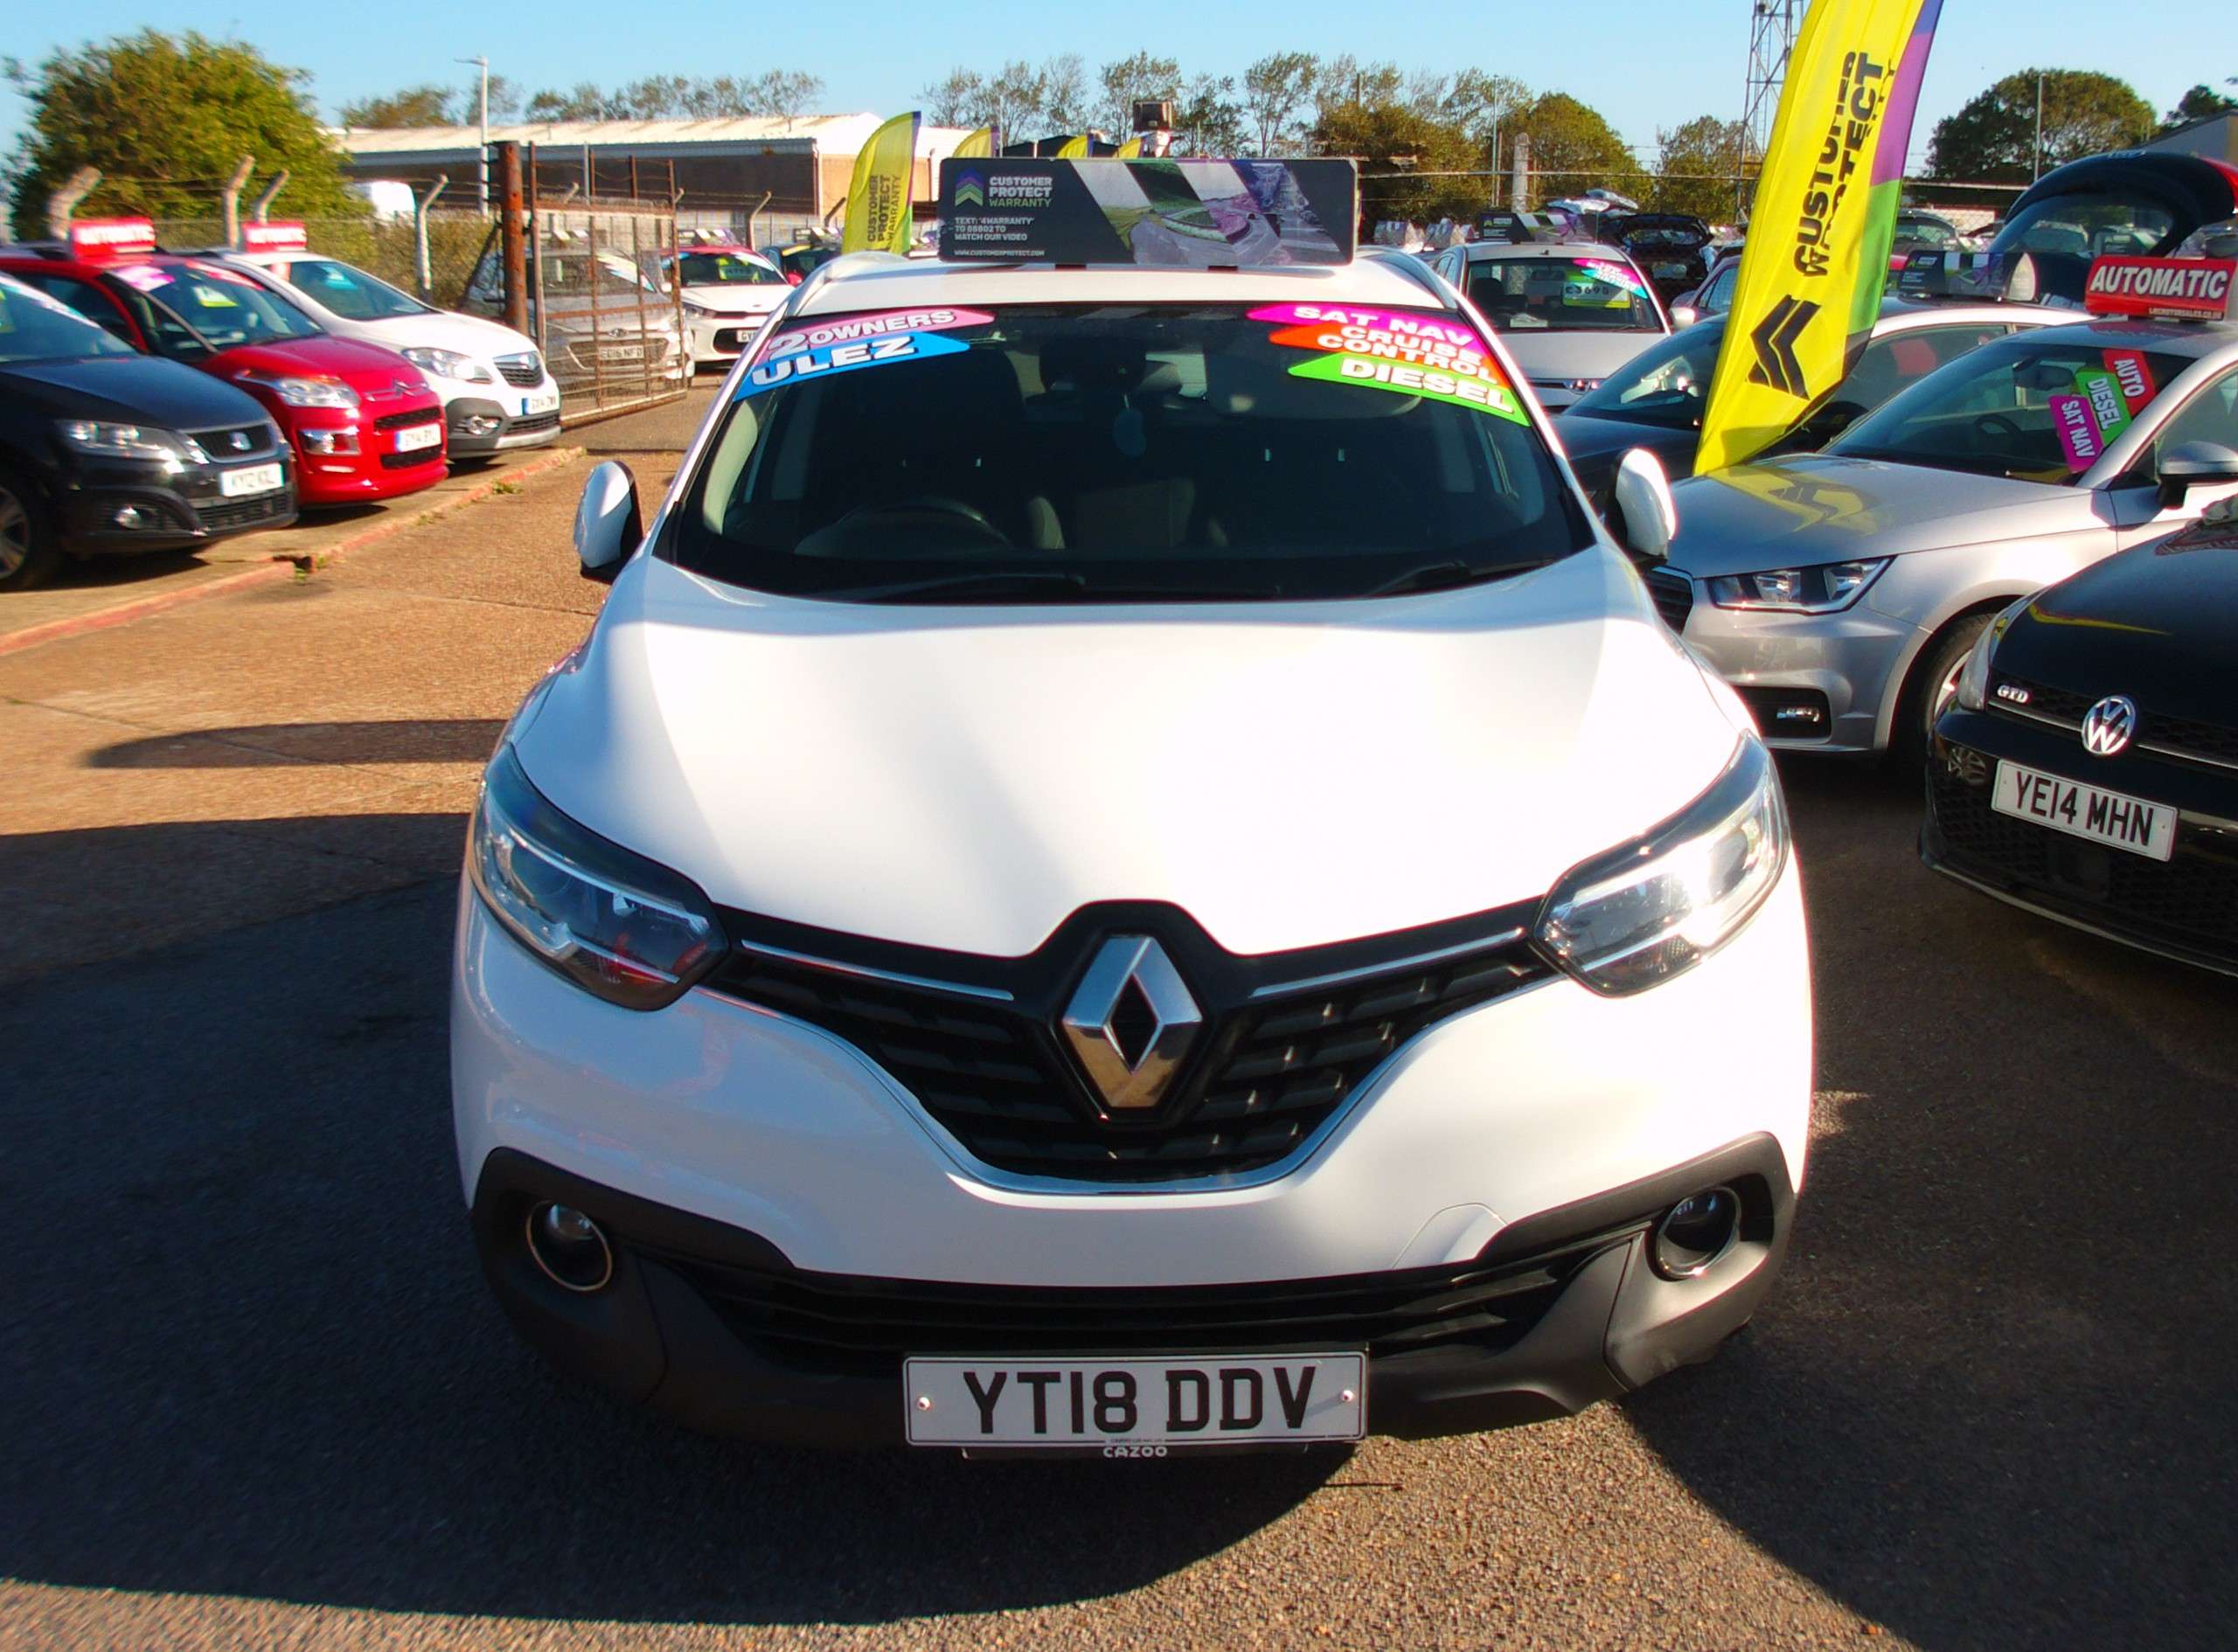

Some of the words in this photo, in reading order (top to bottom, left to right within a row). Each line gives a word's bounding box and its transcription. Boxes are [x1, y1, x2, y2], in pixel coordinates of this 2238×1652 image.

[989, 177, 1053, 186] CUSTOMER
[989, 186, 1053, 198] PROTECT
[867, 176, 879, 242] CUSTOMER
[878, 175, 891, 241] PROTECT
[886, 175, 900, 240] WARRANTY
[989, 198, 1053, 207] WARRANTY
[2089, 265, 2228, 300] AUTOMATIC
[807, 310, 956, 345] OWNERS
[1293, 306, 1379, 327] SAT
[1389, 320, 1475, 346] NAV
[1340, 326, 1484, 364] CRUISE
[752, 336, 915, 385] ULEZ
[1317, 335, 1498, 385] CONTROL
[2114, 358, 2145, 397] AUTO
[1340, 358, 1514, 414] DIESEL
[2088, 378, 2121, 430] DIESEL
[2061, 400, 2086, 426] SAT
[2069, 427, 2096, 456] NAV
[1997, 684, 2029, 704] GTD
[2016, 771, 2078, 824] YE14
[2086, 792, 2154, 846] MHN
[963, 1371, 1137, 1434] YT18
[1165, 1366, 1317, 1432] DDV
[1102, 1446, 1168, 1458] CAZOO
